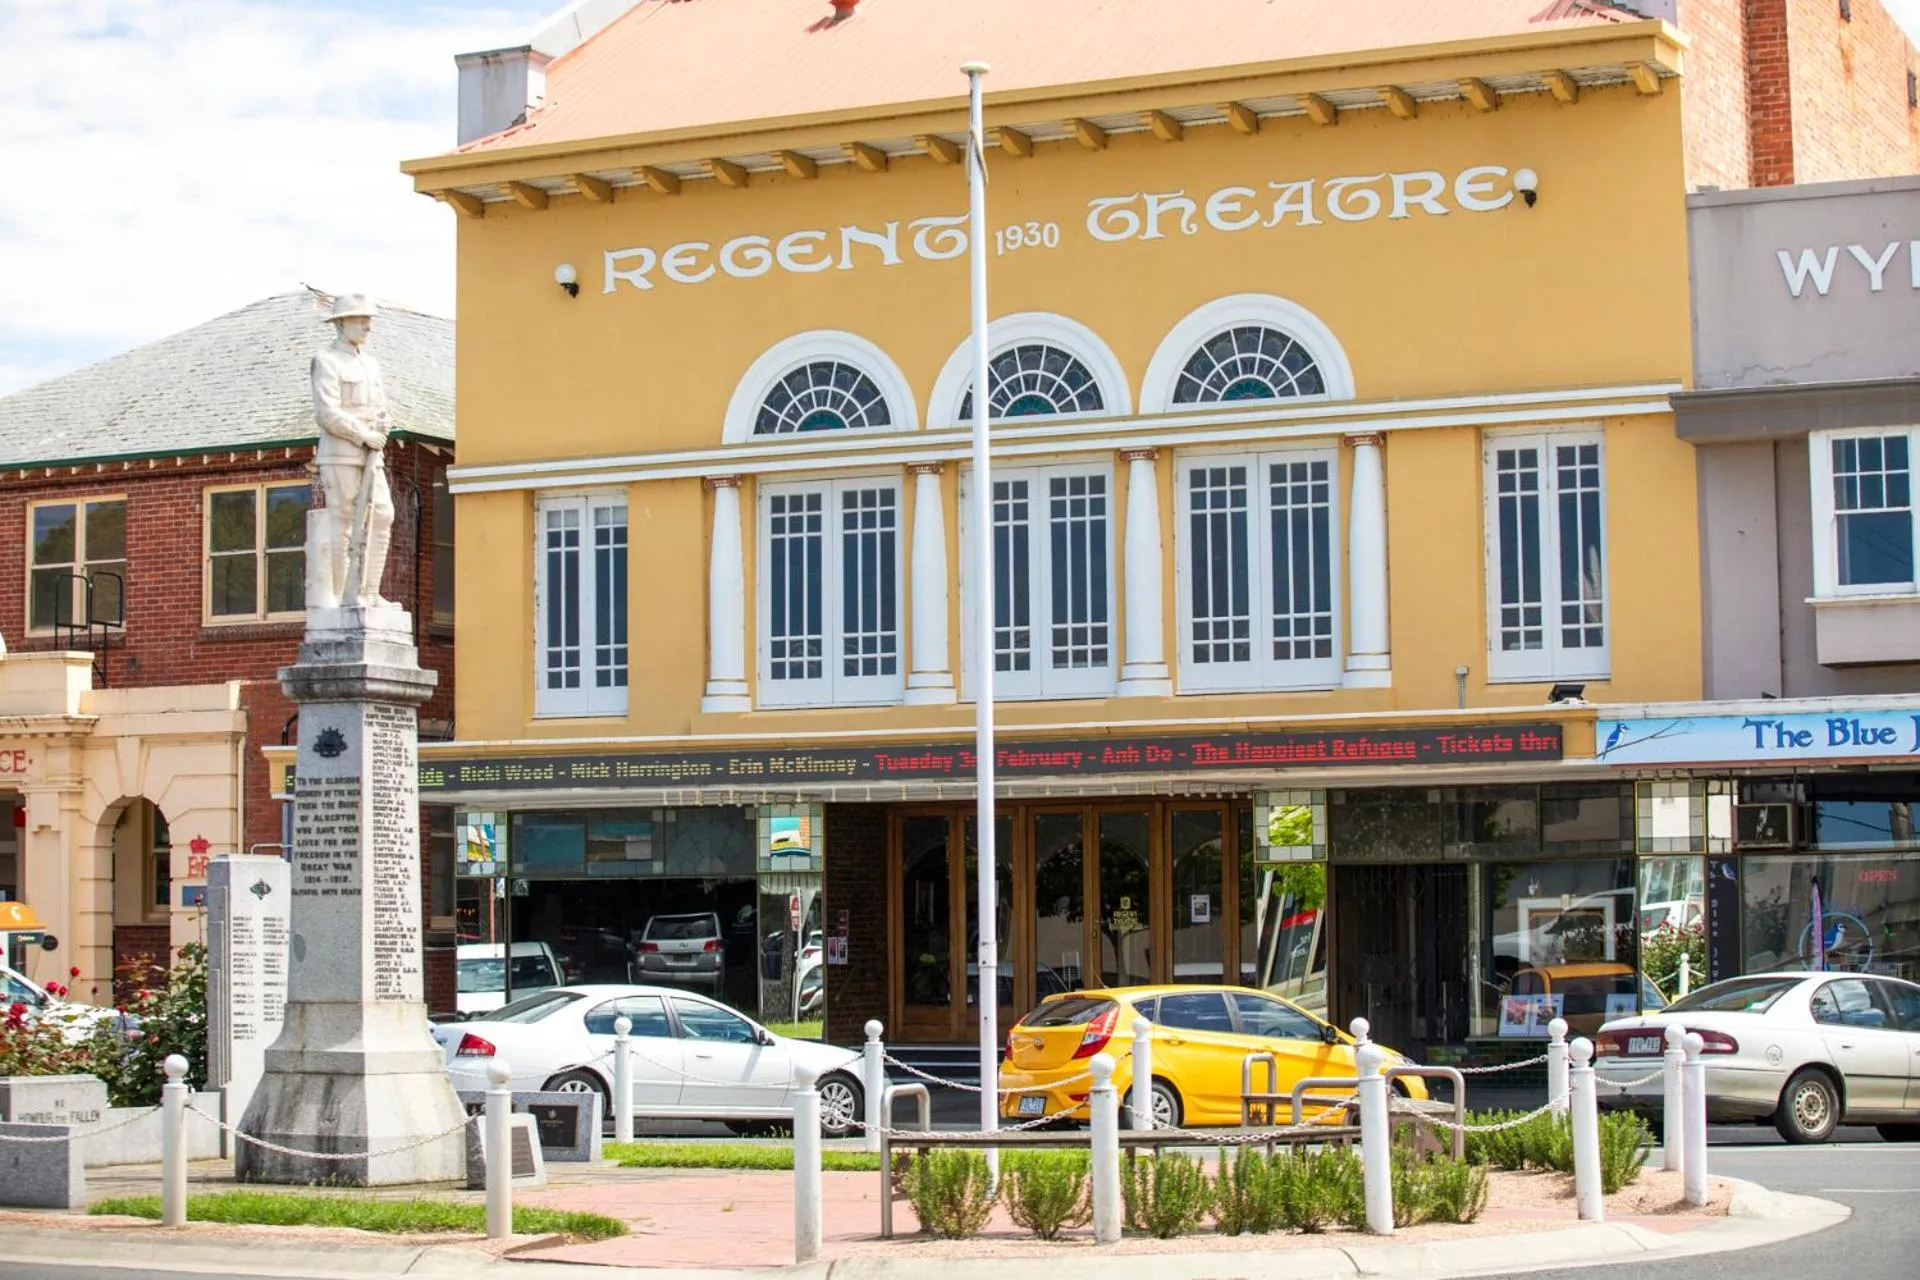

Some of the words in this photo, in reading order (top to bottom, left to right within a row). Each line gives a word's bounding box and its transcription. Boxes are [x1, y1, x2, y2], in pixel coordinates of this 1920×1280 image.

[602, 209, 971, 294] REGENT
[994, 221, 1060, 256] 1930
[1086, 166, 1514, 242] THEATRE
[1776, 240, 1920, 298] WY
[1742, 716, 1814, 749] The
[1825, 717, 1898, 747] Blue
[504, 764, 554, 780] Wood
[571, 762, 610, 778] Mick
[616, 760, 711, 780] Harrington
[729, 758, 763, 774] Erin
[874, 752, 952, 772] Tuesday
[996, 748, 1082, 768] February
[1102, 744, 1140, 764] Anh
[1145, 743, 1173, 763] Do
[1192, 741, 1229, 763] The
[1235, 739, 1328, 762] Happiest
[1332, 737, 1416, 759] Refugee
[1435, 733, 1513, 754] Tickets
[301, 863, 328, 872] GREAT
[332, 862, 353, 871] WAR
